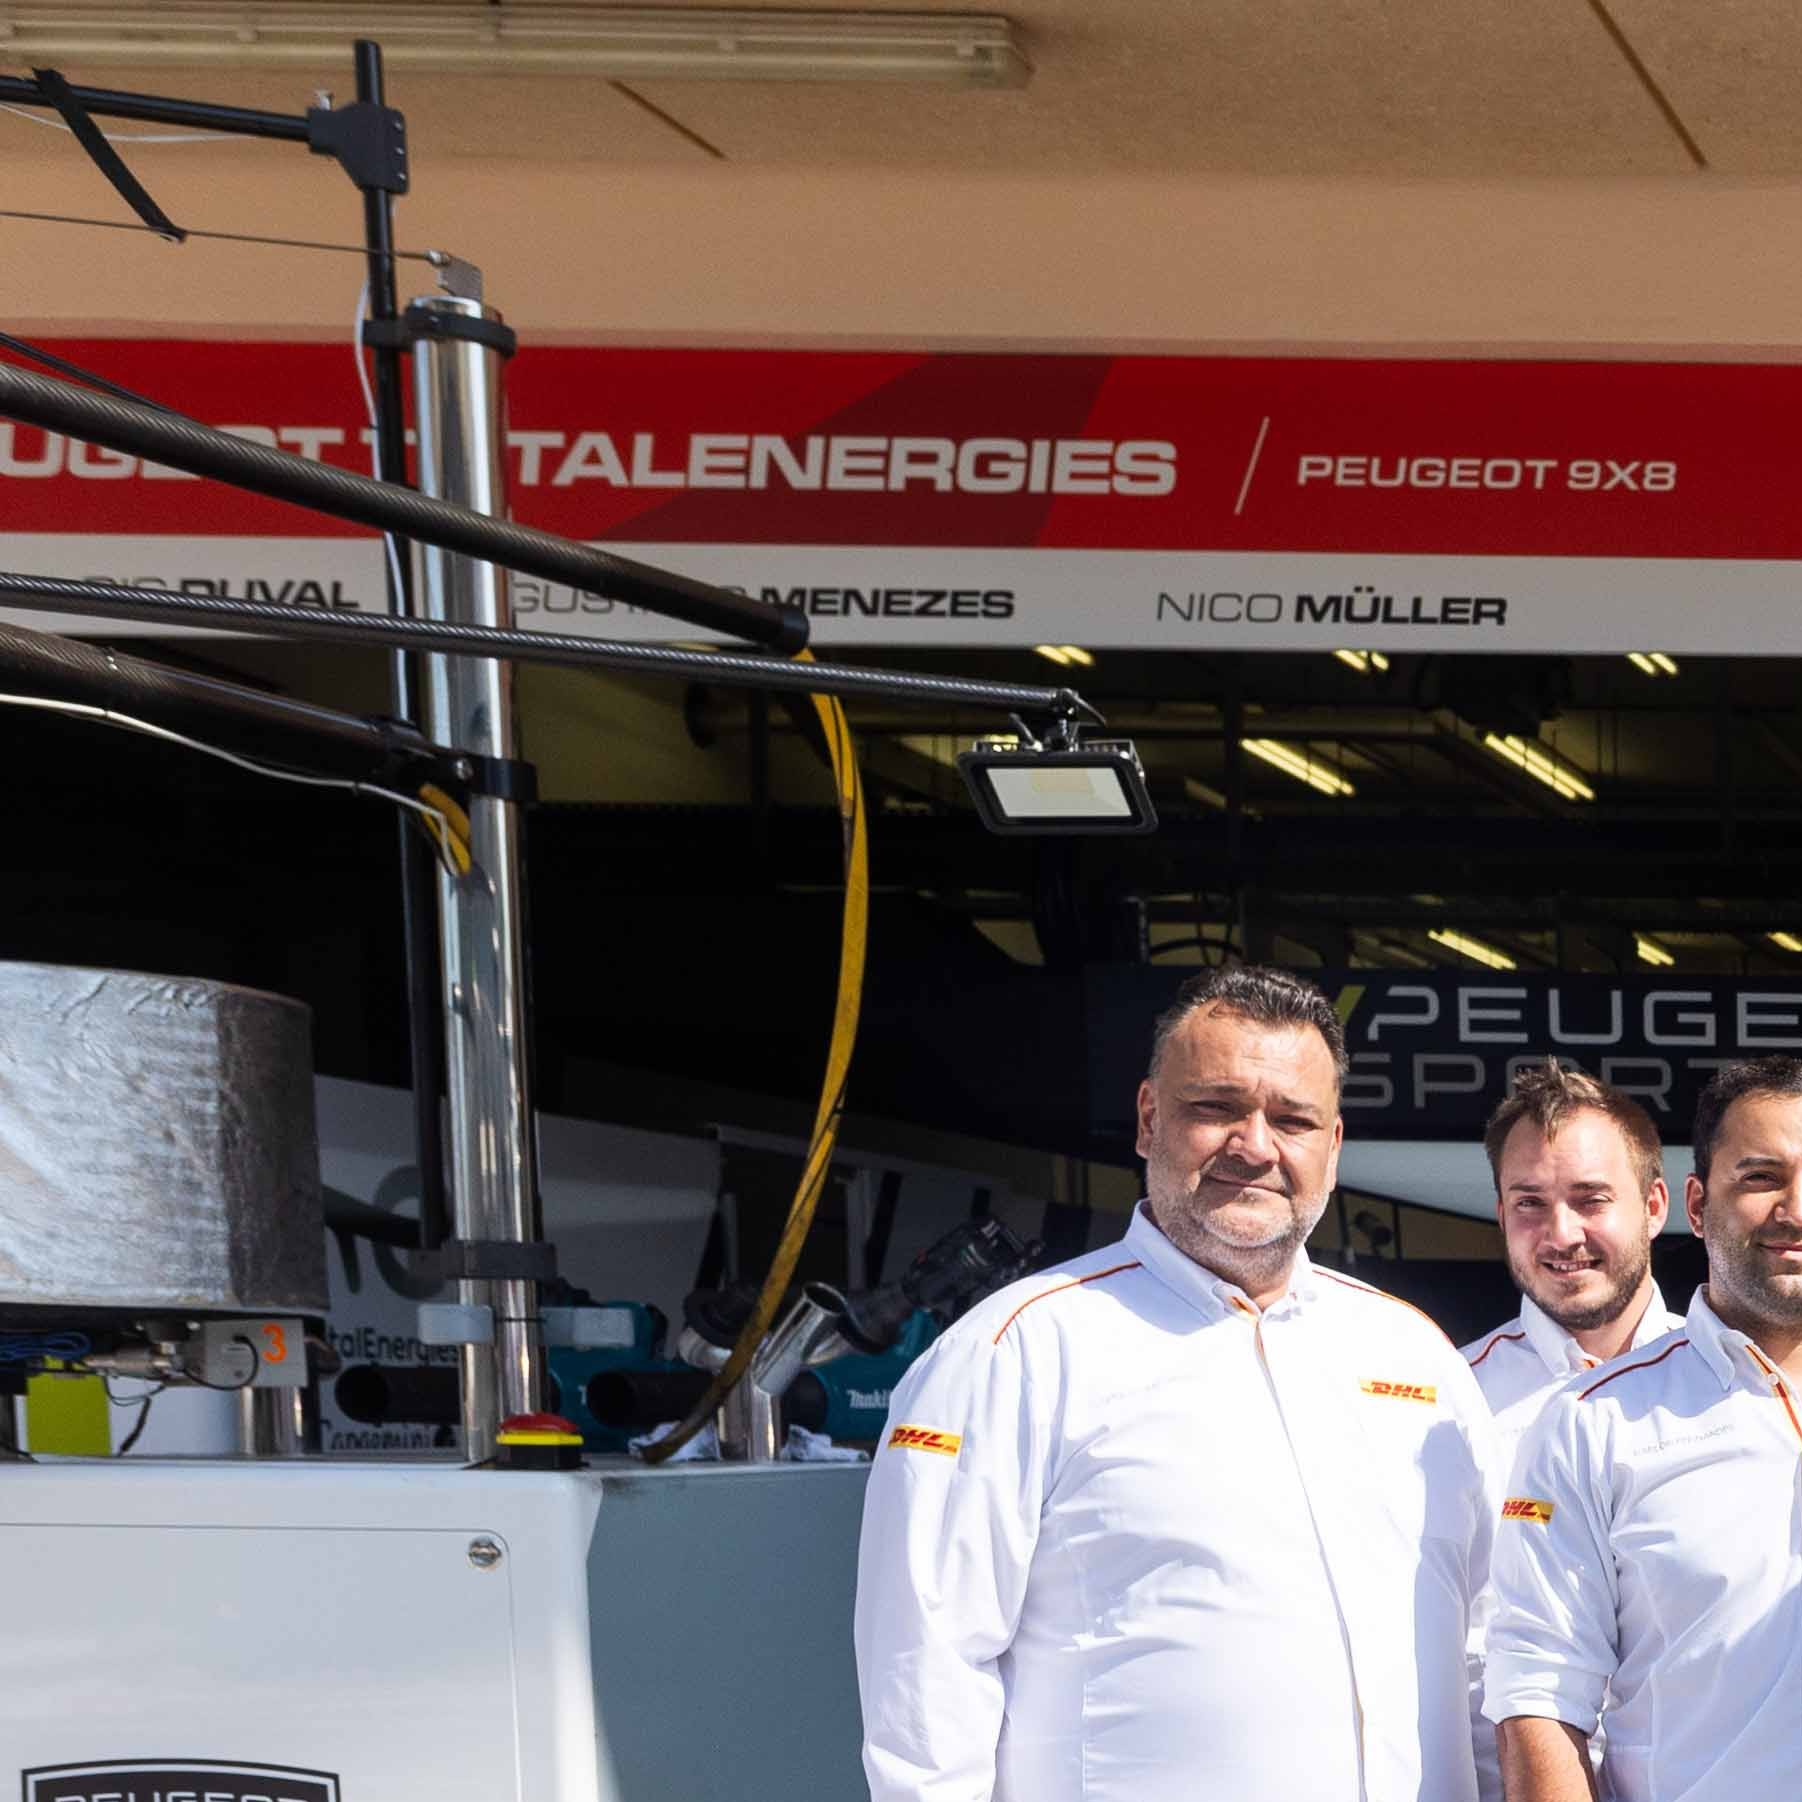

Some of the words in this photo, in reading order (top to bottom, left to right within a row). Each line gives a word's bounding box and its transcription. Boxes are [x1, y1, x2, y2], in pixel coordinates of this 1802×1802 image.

[1297, 455, 1556, 491] PEUGEOT
[1566, 459, 1677, 492] 9X8
[764, 586, 1015, 619] MENEZES
[1157, 591, 1282, 623] NICO
[1293, 585, 1507, 626] MÜLLER
[262, 1322, 288, 1363] 3
[1370, 1380, 1427, 1401] DHL
